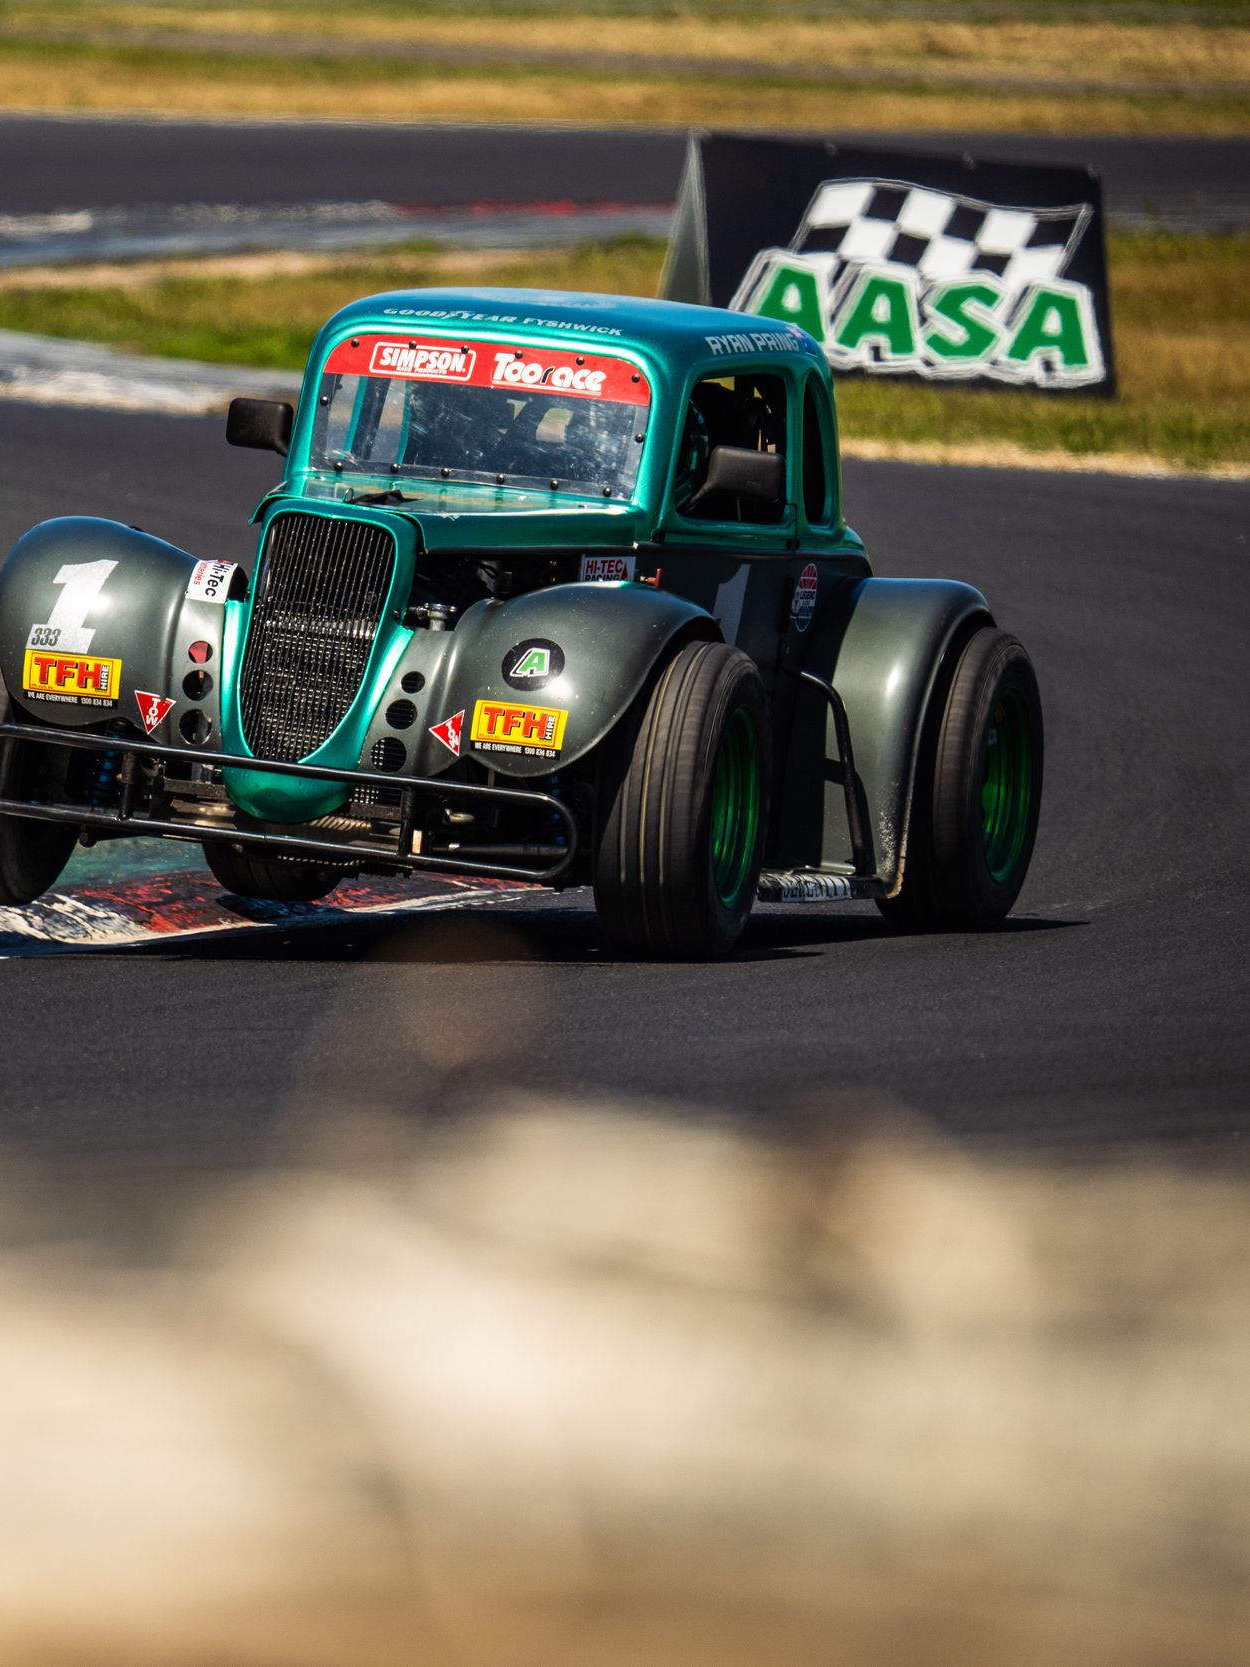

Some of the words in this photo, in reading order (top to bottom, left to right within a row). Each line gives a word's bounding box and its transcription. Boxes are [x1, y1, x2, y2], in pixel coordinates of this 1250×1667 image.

[383, 308, 518, 323] GOODYEAR
[522, 317, 623, 336] FYSHWICK
[740, 258, 1096, 376] AASA
[704, 333, 755, 355] RYAN
[749, 332, 800, 352] PRING
[379, 346, 464, 372] SIMPSON
[585, 559, 623, 574] HI-TEC
[26, 559, 119, 654] 1
[31, 627, 61, 647] 333
[34, 656, 101, 689] TFH
[510, 648, 551, 677] A
[100, 664, 110, 690] HIRE
[46, 694, 78, 704] EVERYWHERE
[146, 697, 161, 726] TOW
[445, 720, 460, 748] TOW
[483, 706, 549, 740] TFH
[545, 715, 556, 740] HIRE
[483, 742, 491, 750] ARE
[492, 743, 522, 753] EVERYWHERE
